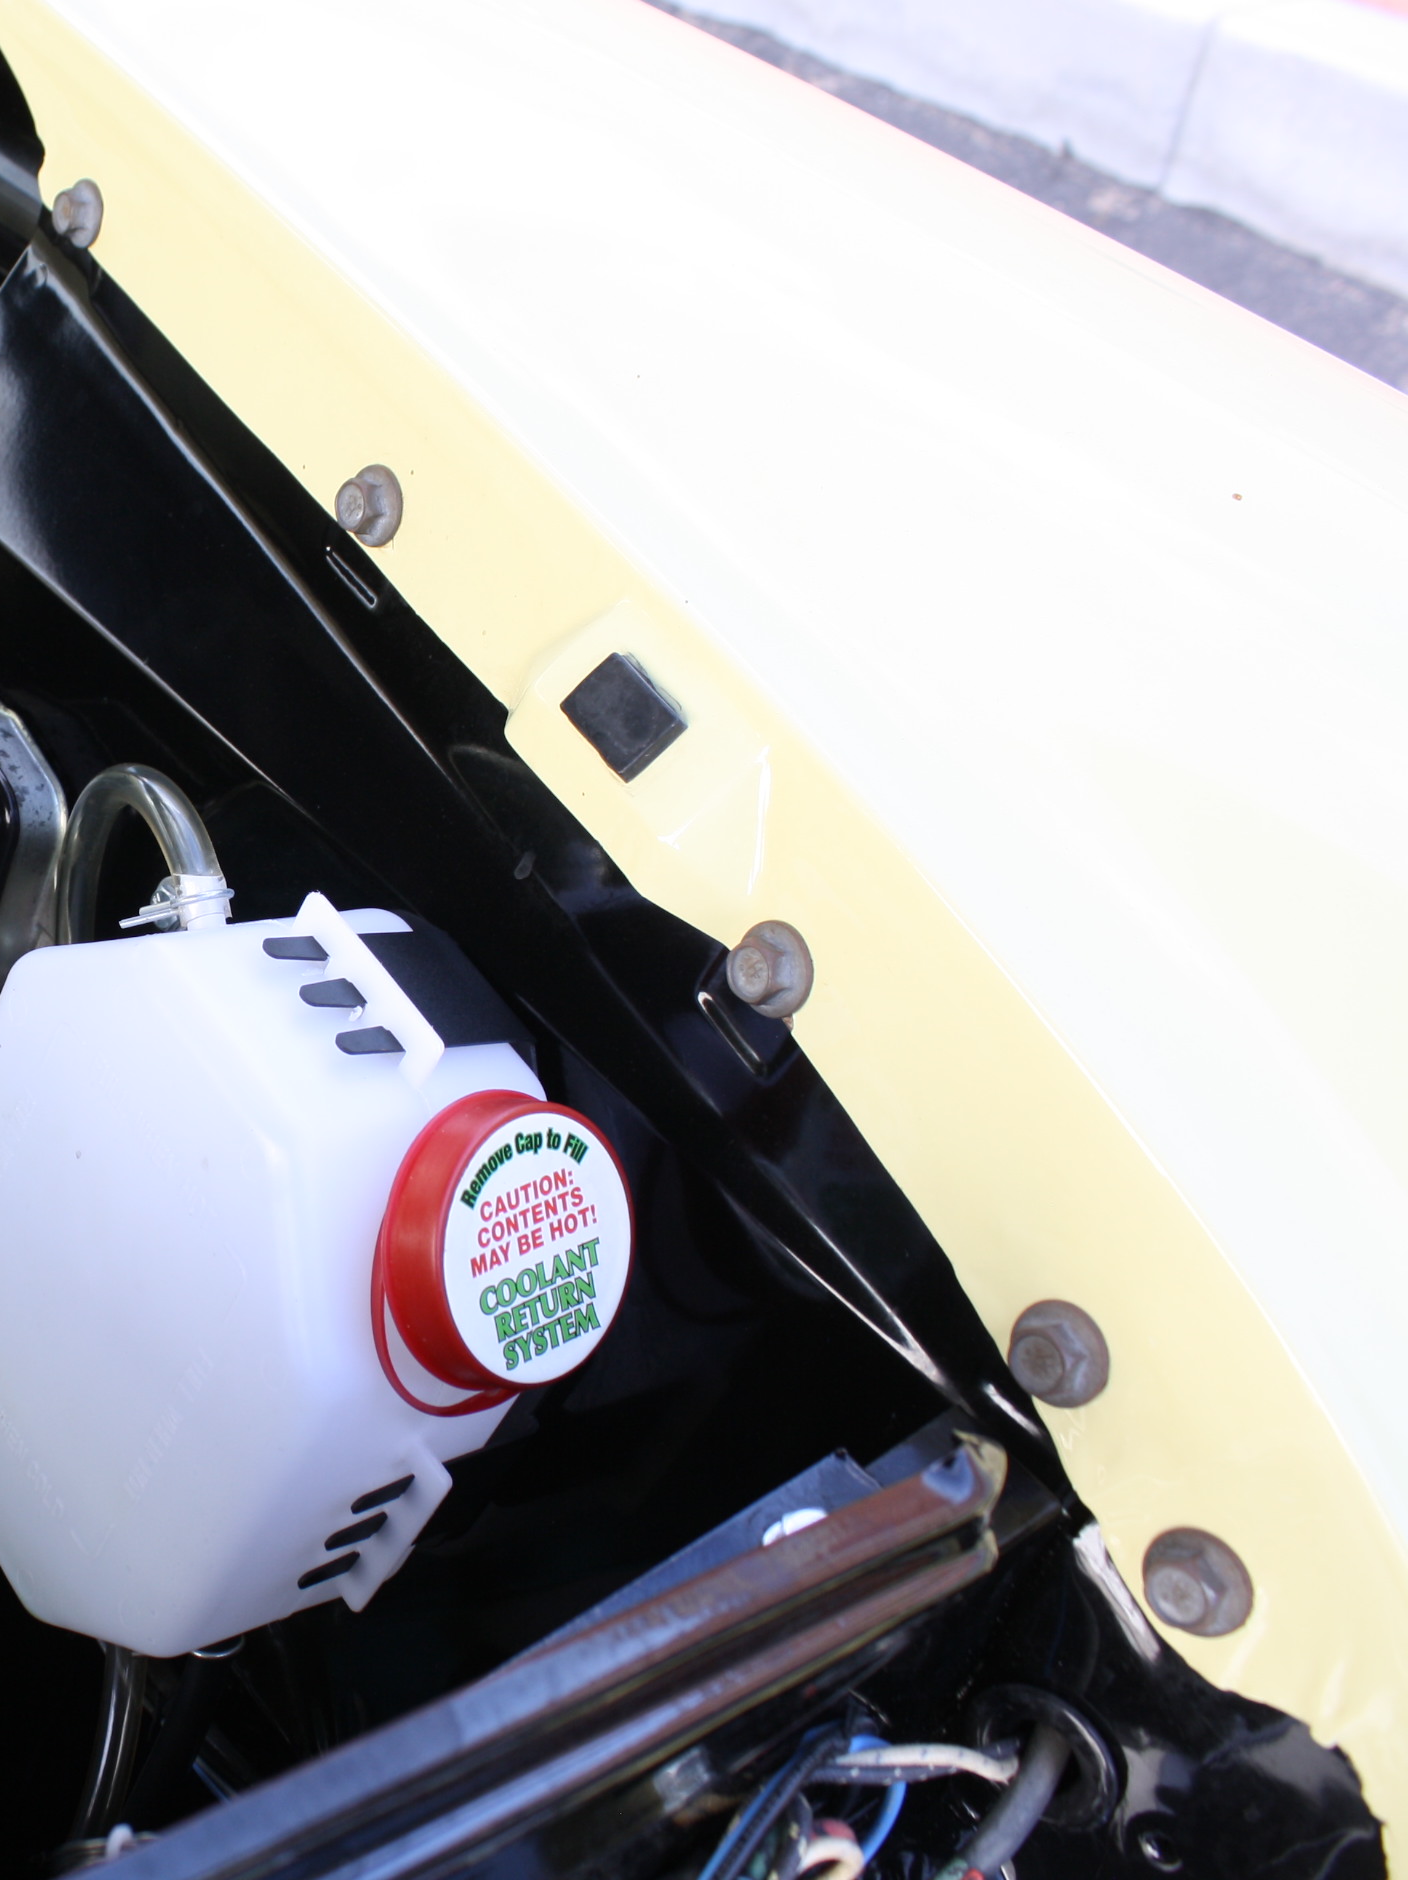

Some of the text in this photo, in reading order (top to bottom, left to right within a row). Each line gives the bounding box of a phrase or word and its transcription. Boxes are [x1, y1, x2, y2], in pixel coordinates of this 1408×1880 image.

[460, 1127, 589, 1210] Remove Cap to Fill
[479, 1167, 574, 1223] CAUTION:
[470, 1203, 598, 1279] MAY BE HOT!
[477, 1186, 584, 1248] CONTENTS
[479, 1236, 600, 1316] COOLANT
[494, 1270, 597, 1343] RETURN
[503, 1301, 602, 1371] SYSTEM
